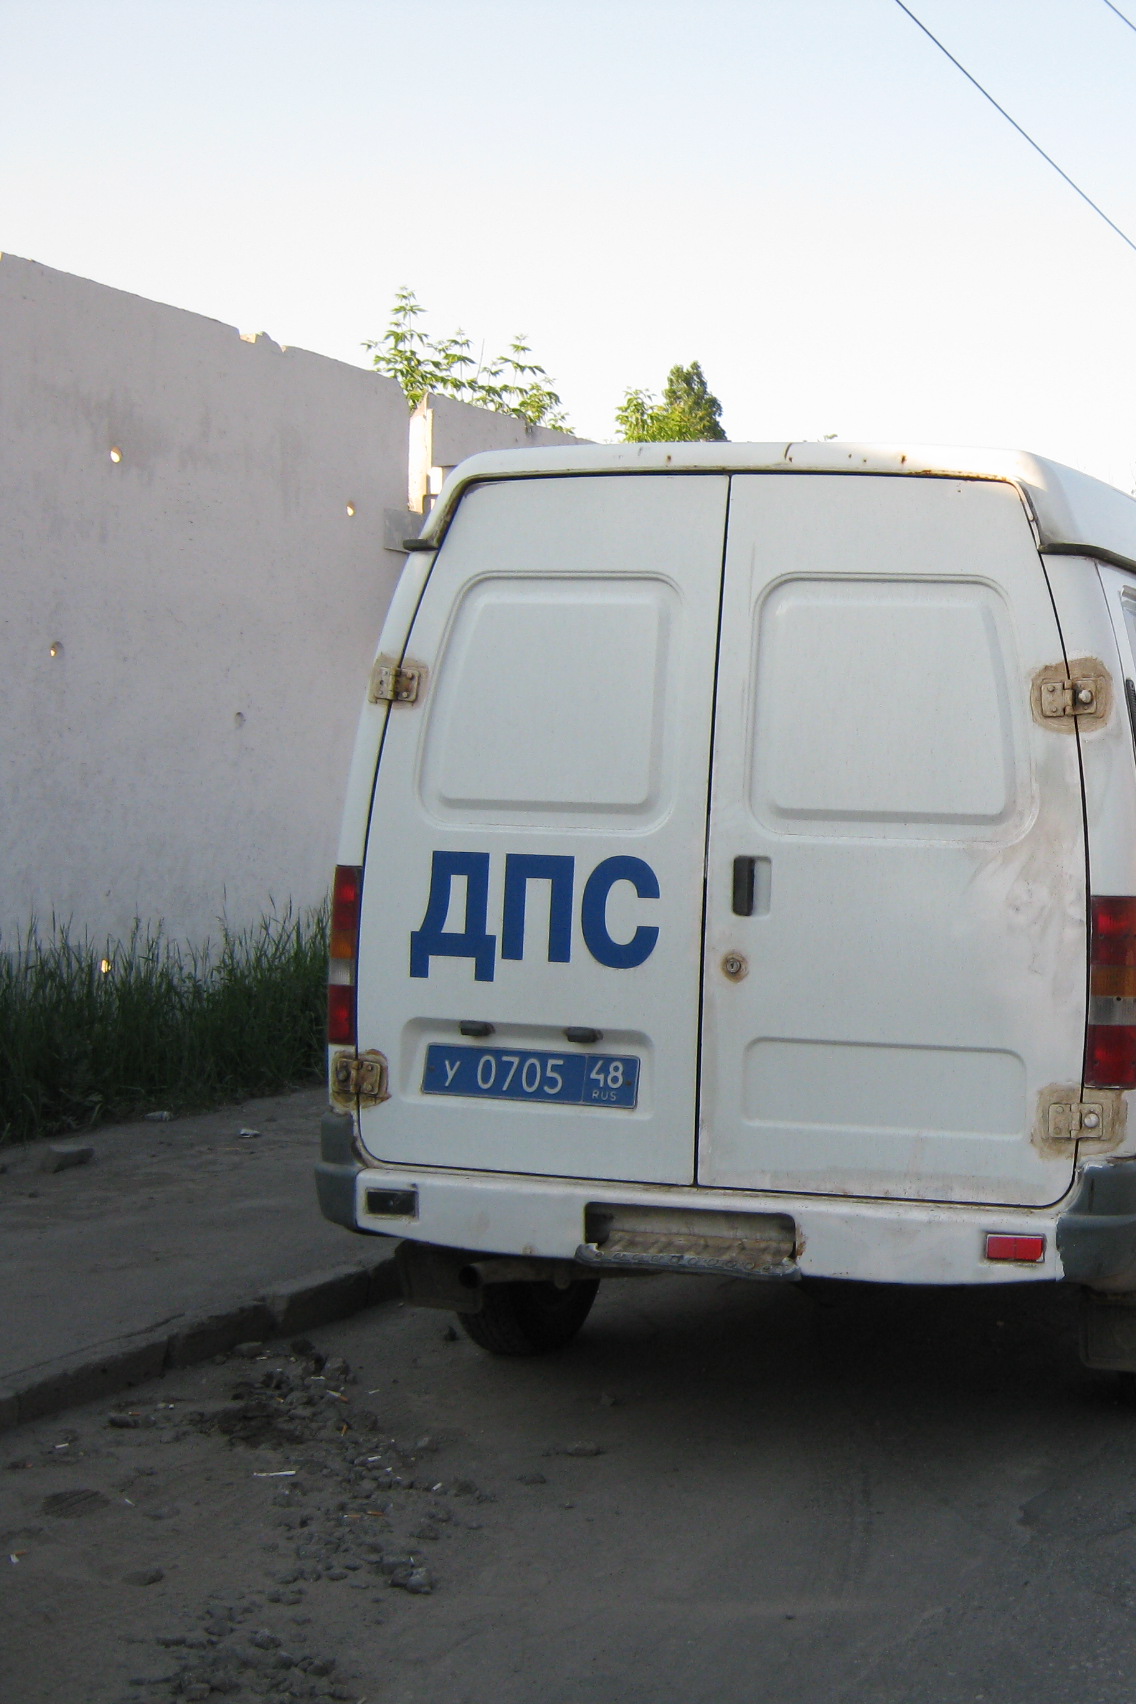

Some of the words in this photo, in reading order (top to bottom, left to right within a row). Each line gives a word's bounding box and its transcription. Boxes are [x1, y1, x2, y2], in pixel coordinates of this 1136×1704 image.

[409, 850, 661, 982] ДПС
[476, 1054, 565, 1095] 0705
[589, 1060, 624, 1089] 48
[592, 1090, 617, 1102] RUS
